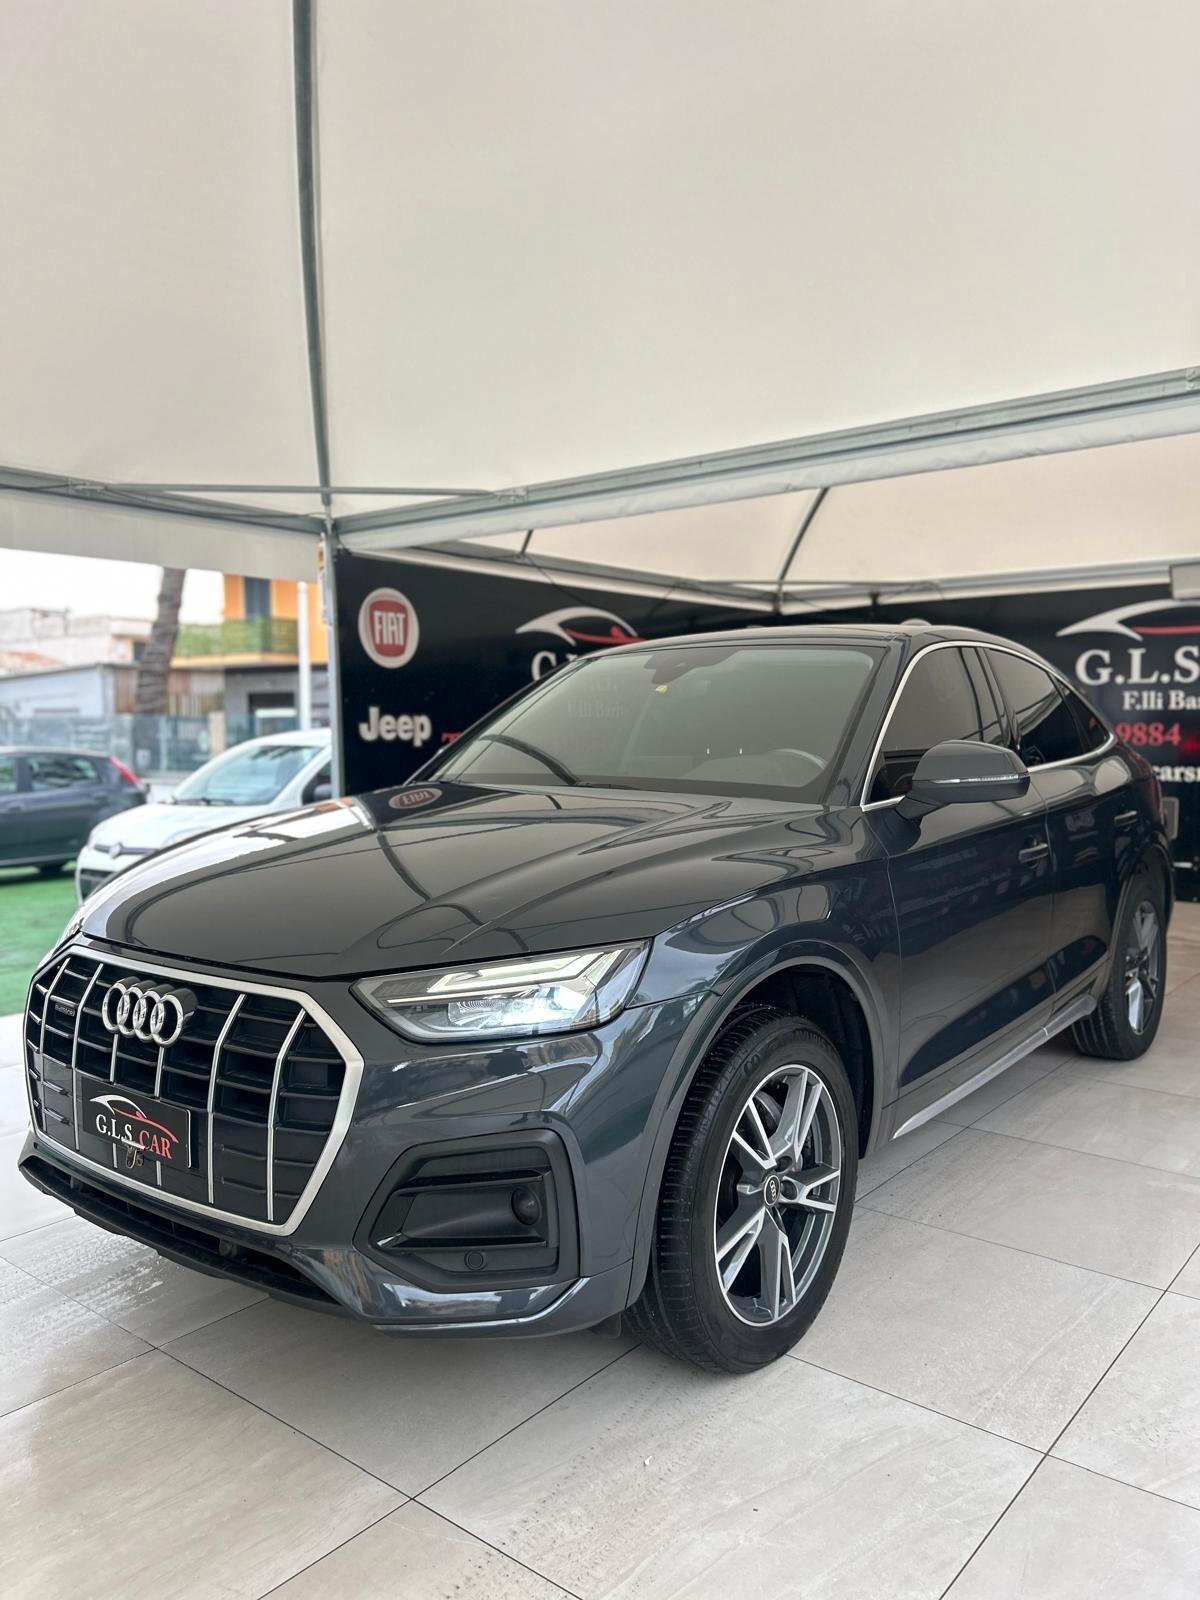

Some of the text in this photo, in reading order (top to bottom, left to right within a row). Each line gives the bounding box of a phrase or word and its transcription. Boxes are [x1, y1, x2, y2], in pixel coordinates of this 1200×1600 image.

[373, 611, 406, 646] FIAT
[1075, 645, 1200, 686] G.L.S
[1123, 690, 1164, 711] F.lli
[358, 706, 433, 747] Jeep
[1115, 722, 1181, 746] 9884
[95, 1113, 173, 1160] G.L.S CAR
